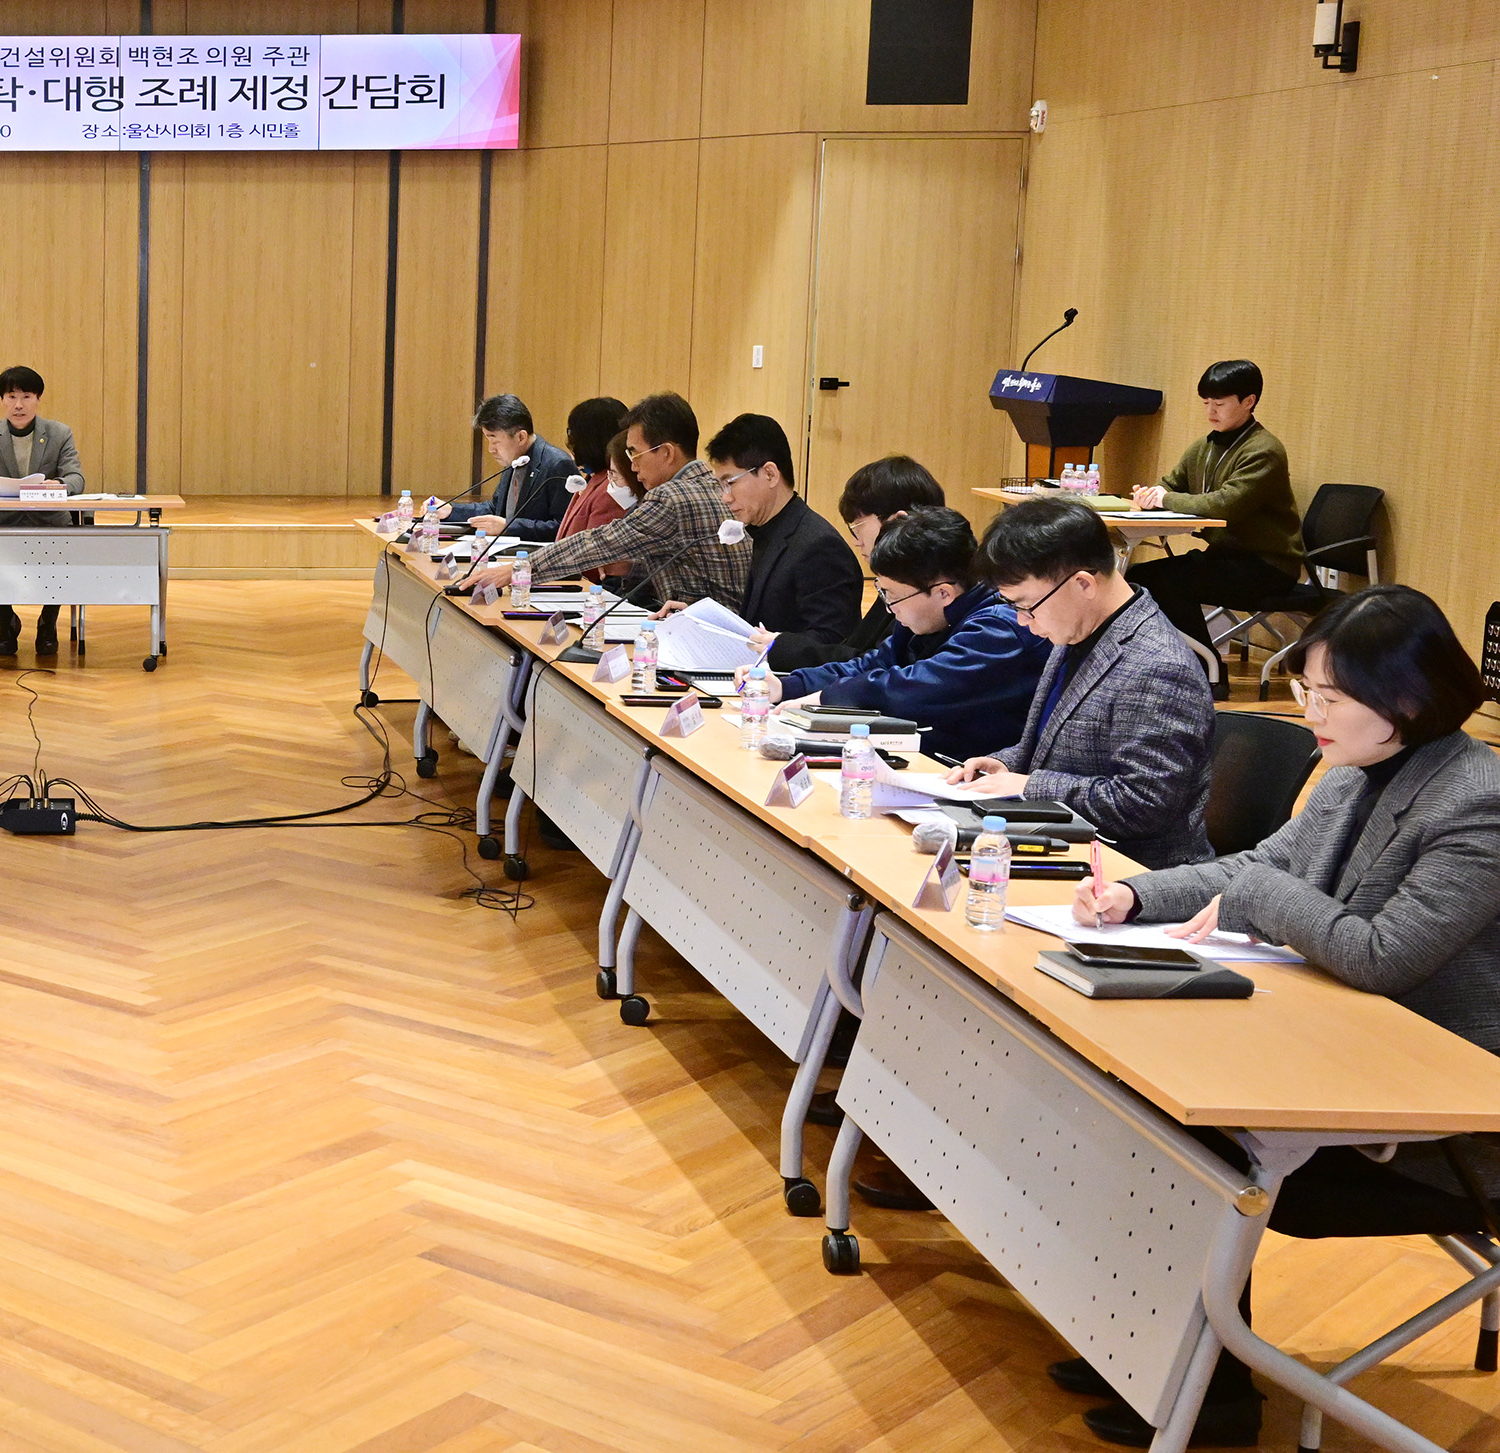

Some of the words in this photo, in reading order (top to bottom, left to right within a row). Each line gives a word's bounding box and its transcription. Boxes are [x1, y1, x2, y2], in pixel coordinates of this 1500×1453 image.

[128, 46, 200, 69] 백현조
[205, 45, 252, 68] 의원
[262, 45, 311, 68] 주관
[134, 75, 217, 112] 조례
[227, 74, 308, 111] 제정
[321, 73, 446, 110] 간담회
[217, 122, 245, 139] 1층
[248, 122, 302, 139] 시민홀
